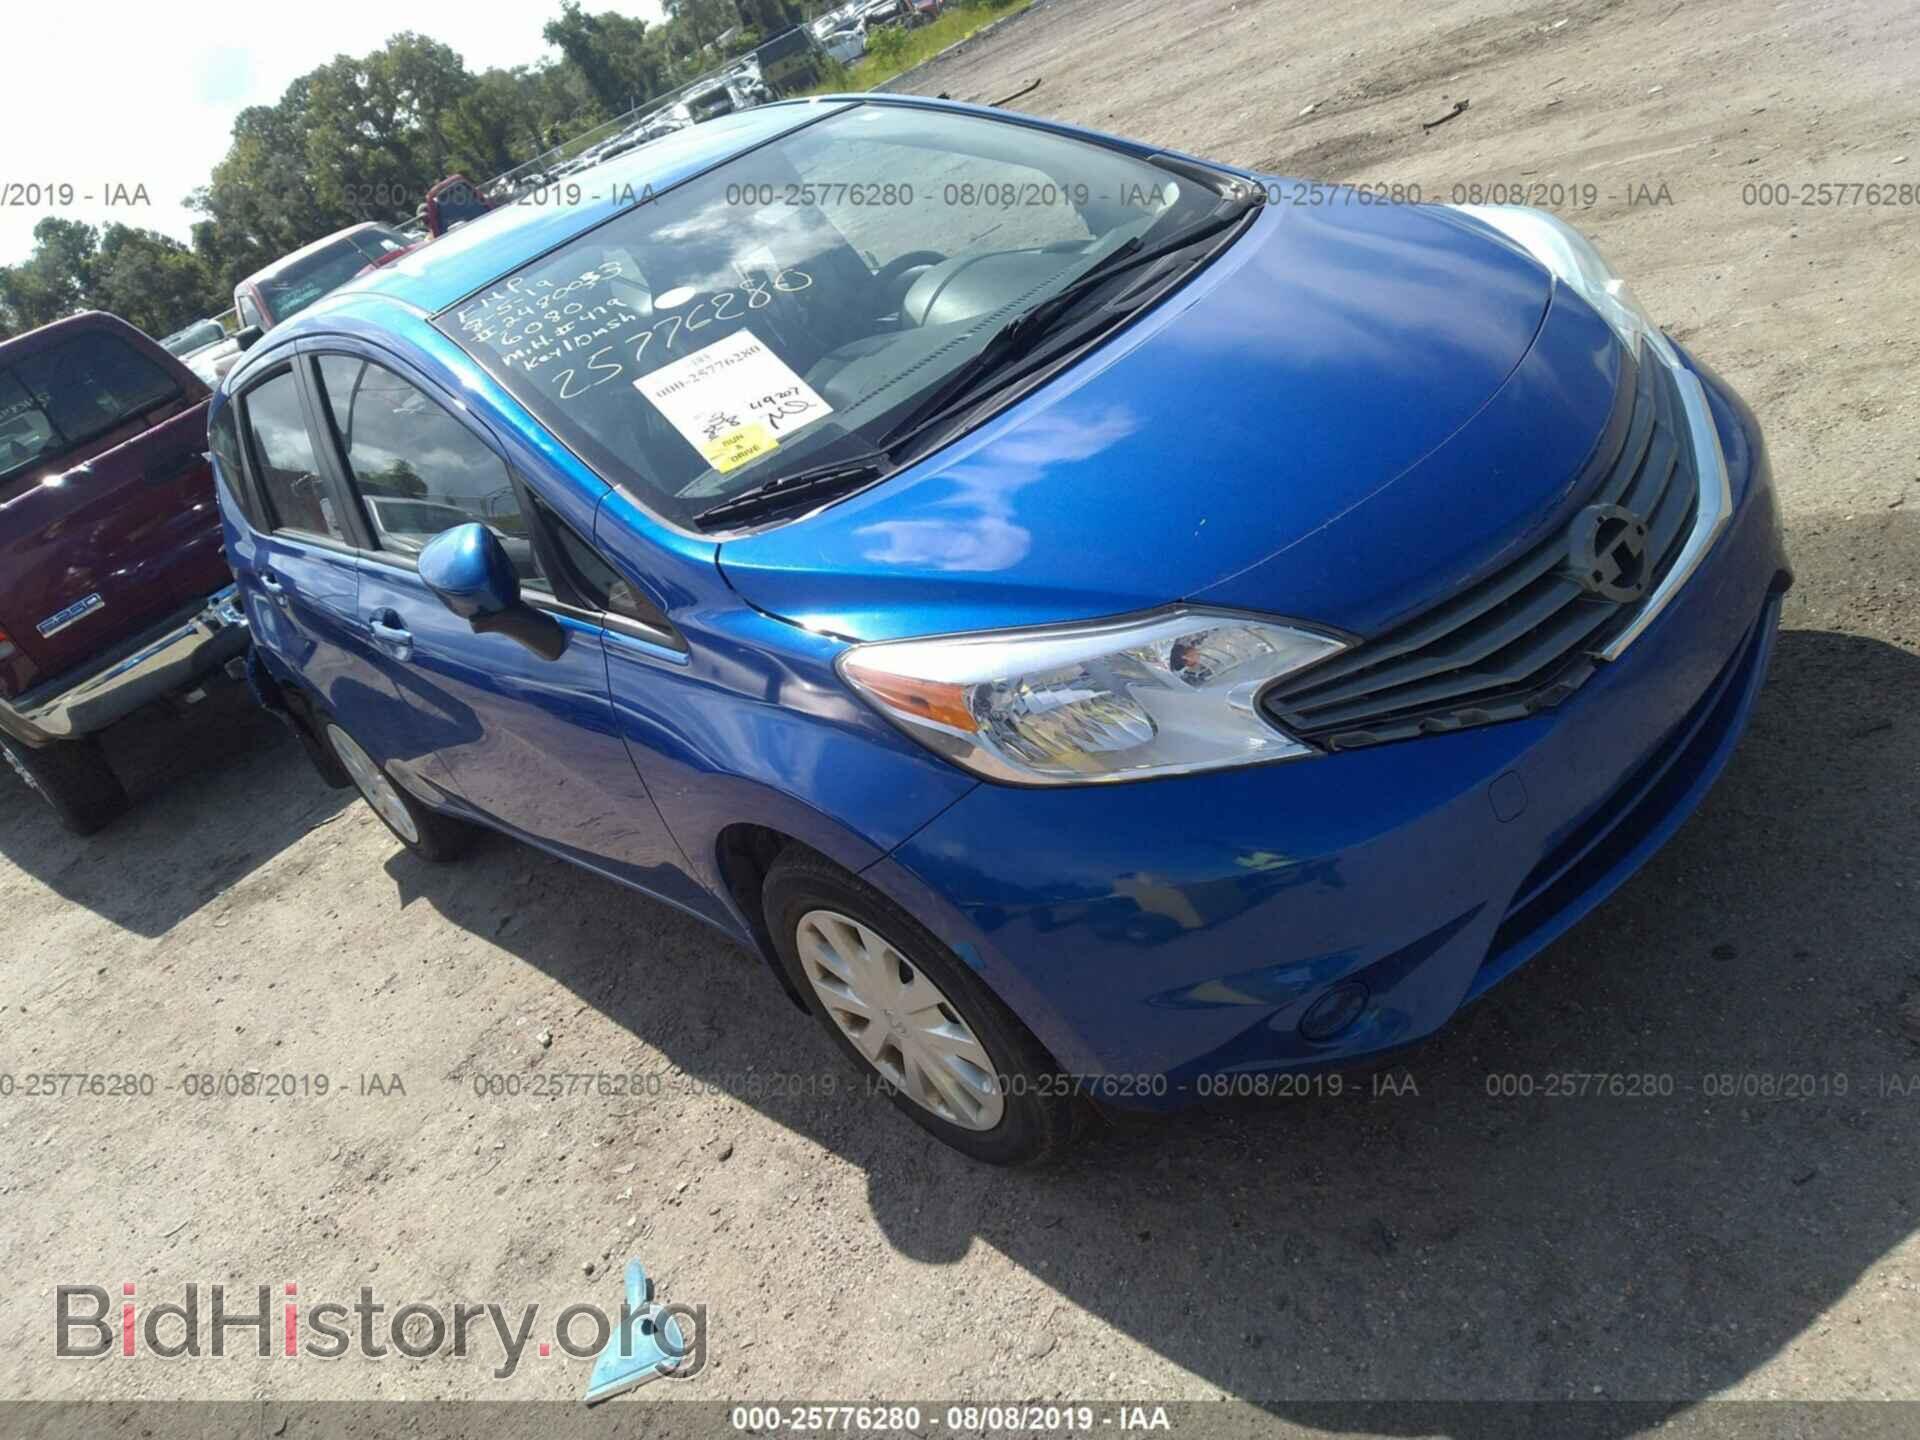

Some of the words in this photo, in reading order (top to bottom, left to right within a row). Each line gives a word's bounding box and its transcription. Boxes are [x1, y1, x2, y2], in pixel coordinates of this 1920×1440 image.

[501, 303, 583, 345] 6080
[552, 269, 812, 399] 25776280
[730, 444, 760, 462] DRIVE
